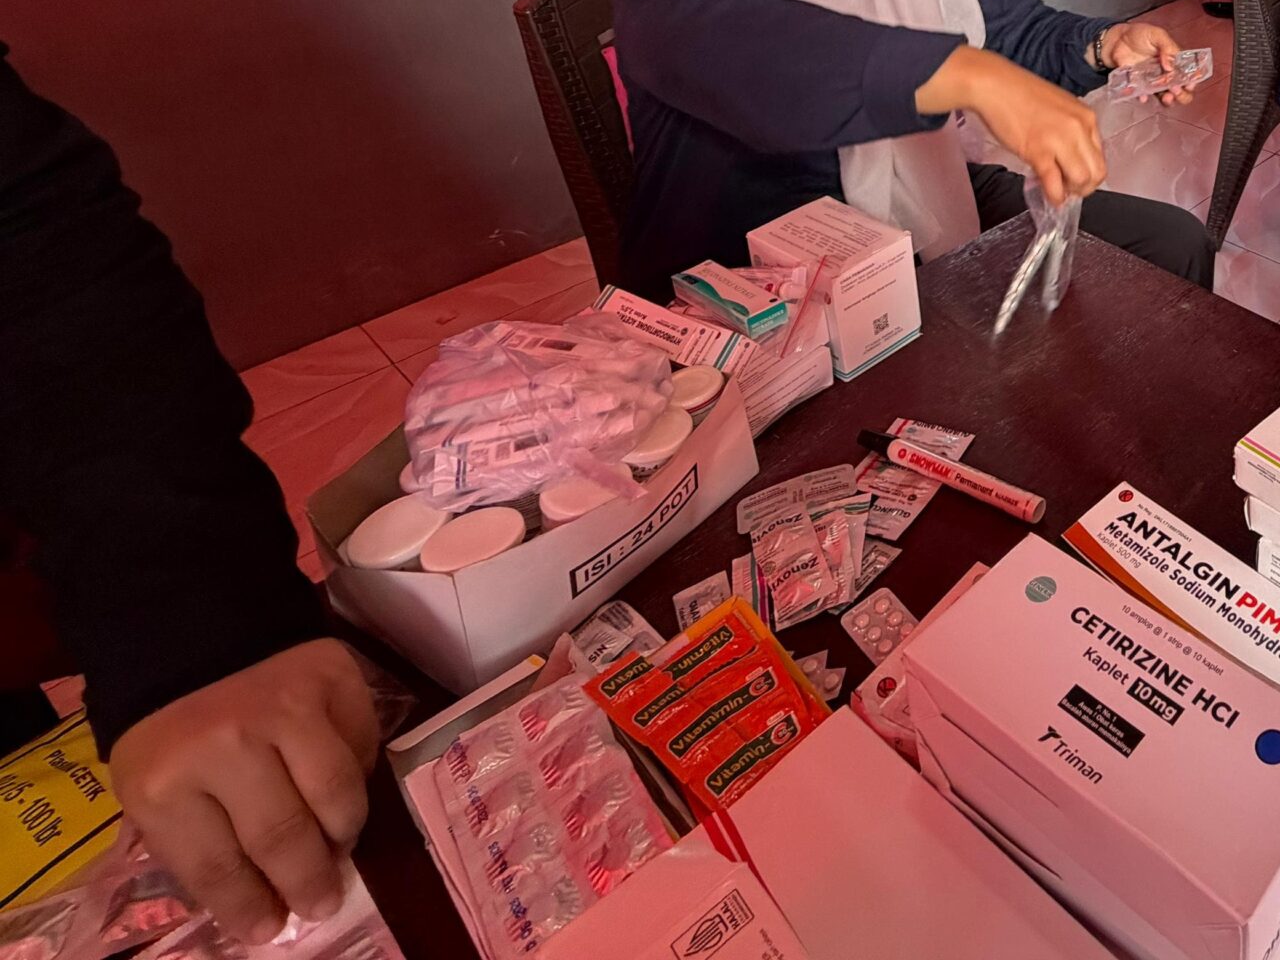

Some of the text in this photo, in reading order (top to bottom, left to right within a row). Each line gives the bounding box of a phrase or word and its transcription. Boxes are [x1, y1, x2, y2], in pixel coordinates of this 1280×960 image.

[909, 453, 952, 478] SNOWMAN
[954, 473, 993, 496] Permanent
[584, 553, 611, 582] ISI
[632, 520, 654, 547] 24
[660, 478, 691, 523] POT
[1097, 532, 1142, 569] Kaplet 500 mg
[1104, 522, 1169, 573] Metamizole
[1169, 569, 1217, 608] Sodium
[1121, 605, 1131, 615] 10
[1130, 611, 1153, 630] amplop
[1152, 625, 1162, 636] @
[1167, 634, 1183, 650] strip
[1182, 645, 1193, 656] @
[1192, 650, 1203, 662] 10
[1202, 656, 1225, 677] kaplet
[1070, 607, 1240, 730] CETIRIZINE HCl
[1083, 647, 1130, 685] Kaplet
[1053, 739, 1104, 784] Triman
[70, 766, 107, 803] CETIK
[17, 796, 56, 831] 100
[719, 900, 741, 931] HALAL
